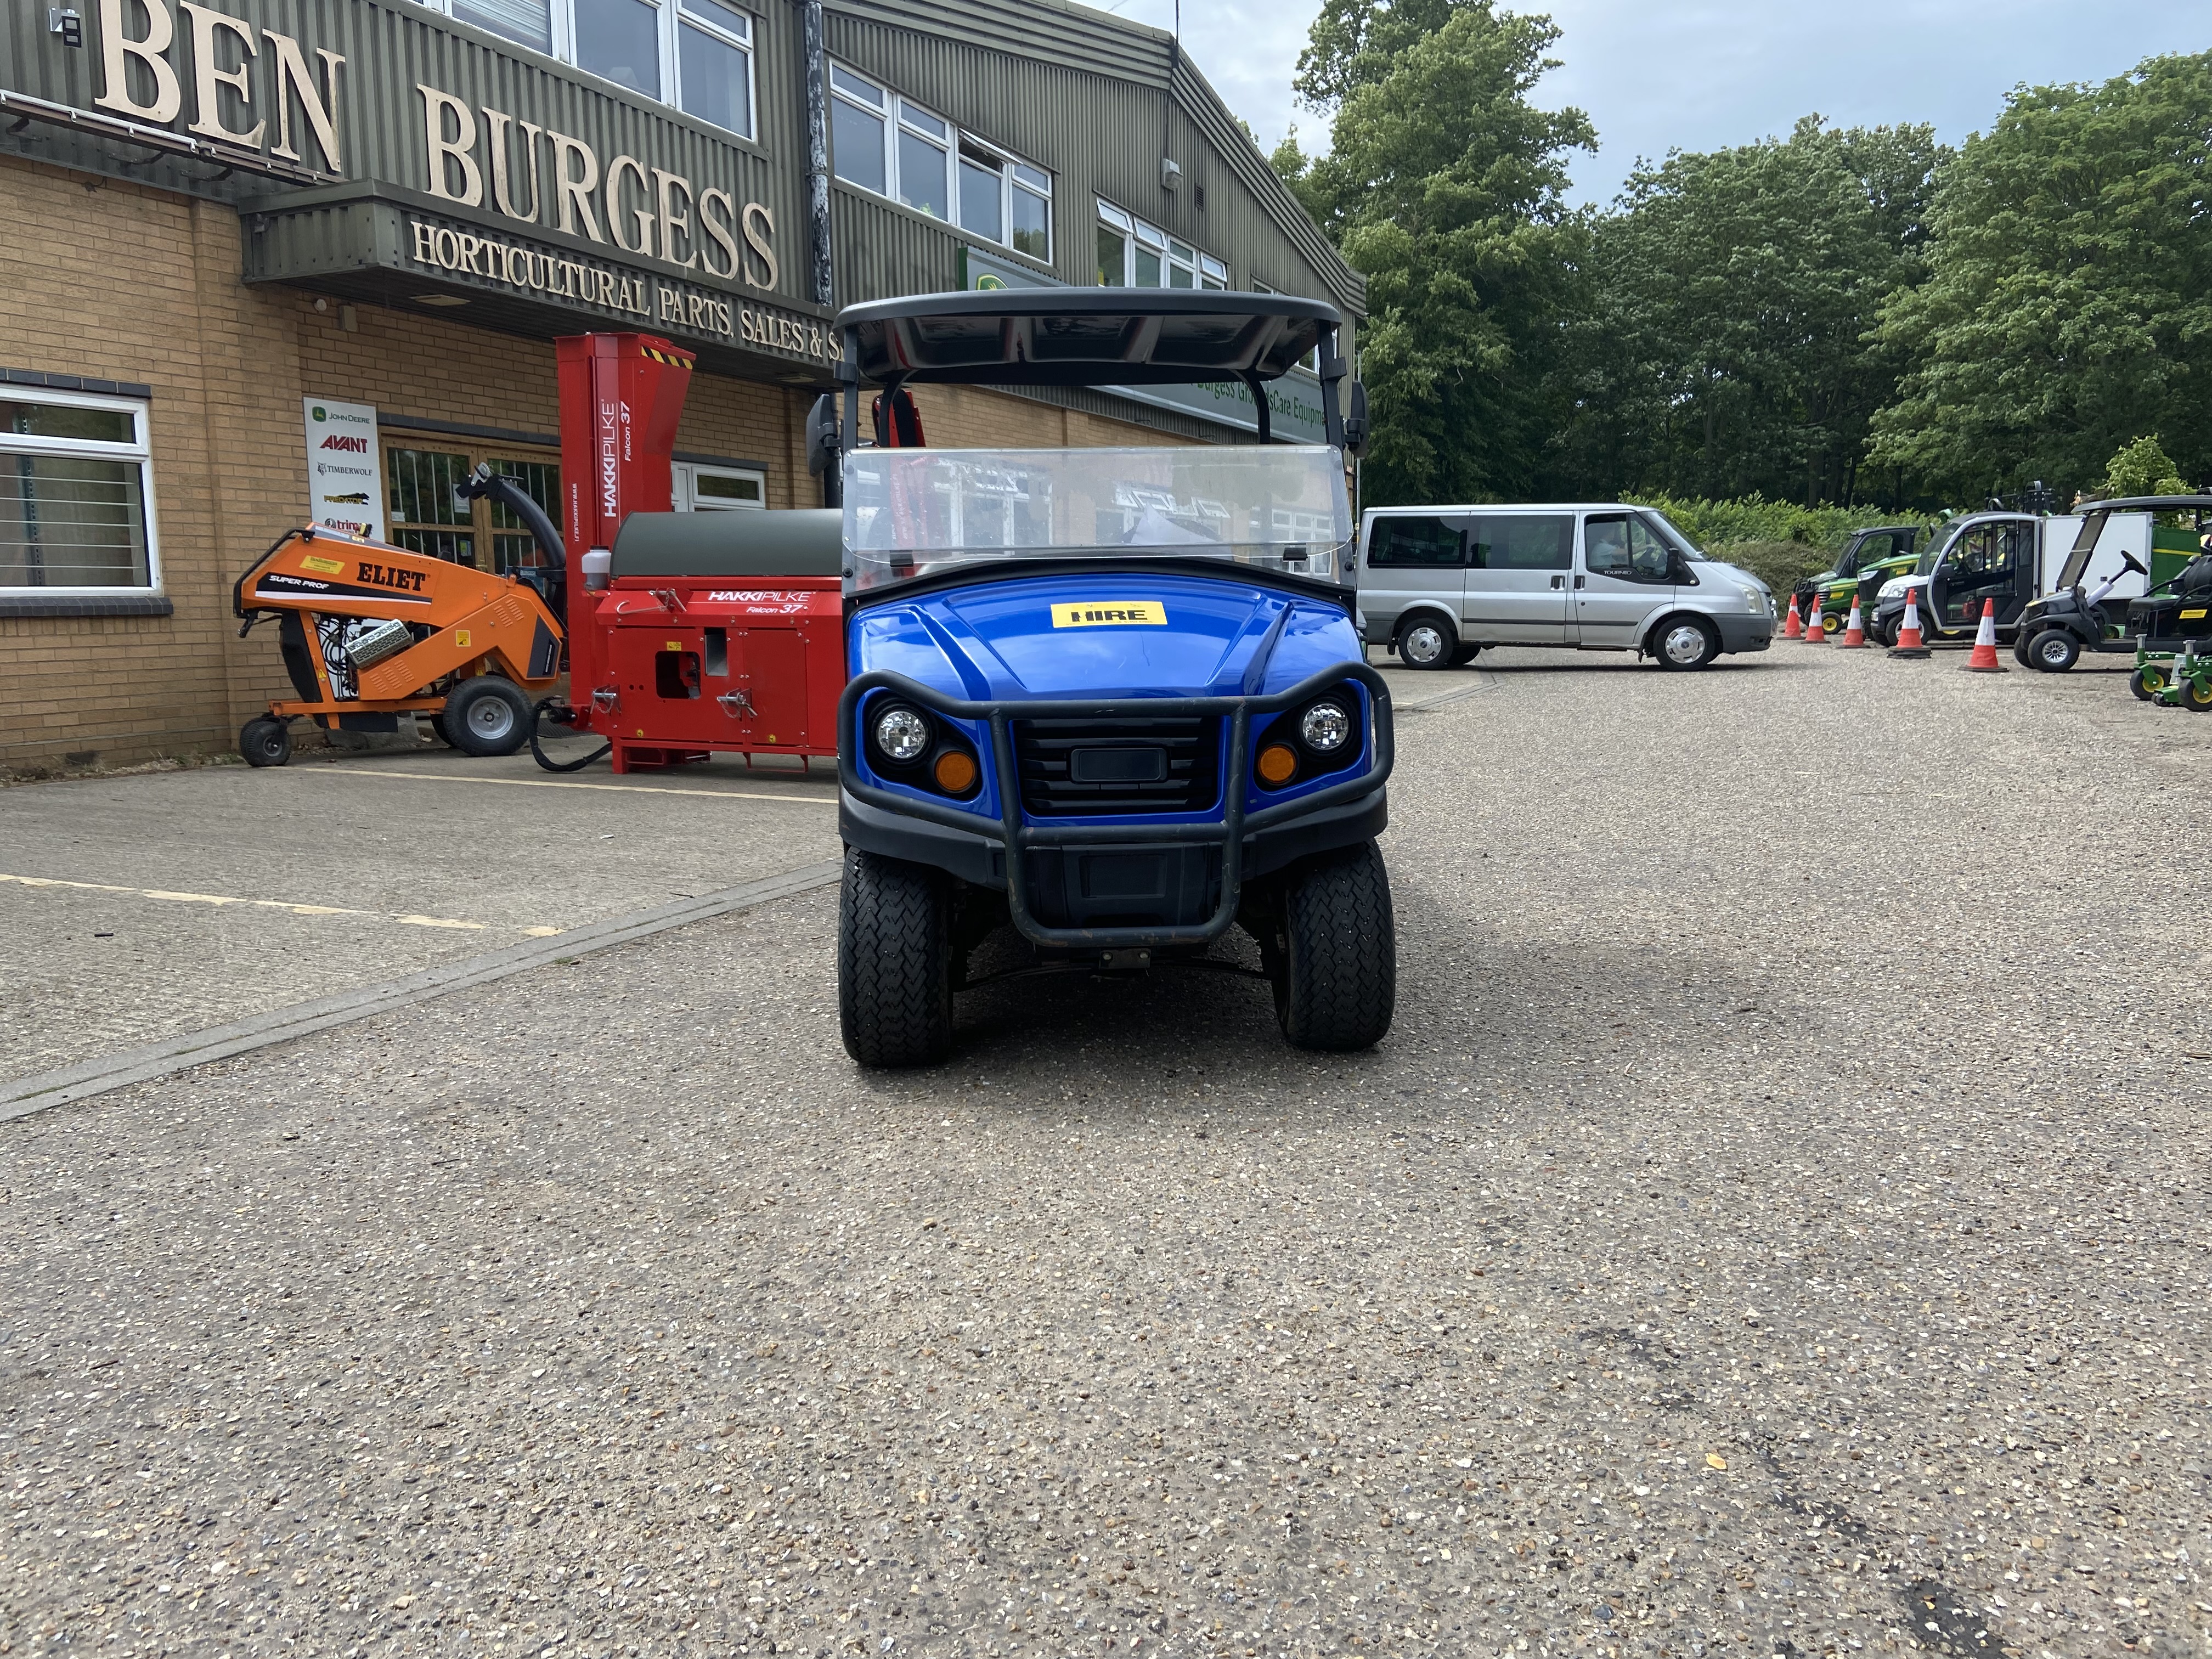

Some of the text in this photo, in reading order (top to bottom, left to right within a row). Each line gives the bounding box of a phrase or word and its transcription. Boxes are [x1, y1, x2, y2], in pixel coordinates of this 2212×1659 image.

[94, 0, 778, 290] BEN BURGESS
[410, 221, 651, 316] HORTICULTURAL
[659, 287, 734, 338] PARTS,
[741, 310, 804, 352] SALES
[810, 327, 823, 357] &
[620, 401, 630, 424] 37
[1294, 397, 1325, 427] Equipme
[320, 435, 368, 453] AVANT
[602, 403, 617, 517] HAKKIPILKE
[327, 465, 373, 476] TIMBERWOLF
[324, 495, 363, 505] PREDATOR
[269, 575, 329, 589] SUPER PROF
[357, 562, 425, 591] ELIET
[708, 591, 812, 601] HAKKIPILKE
[780, 605, 803, 613] 37
[1071, 610, 1148, 622] HIRE
